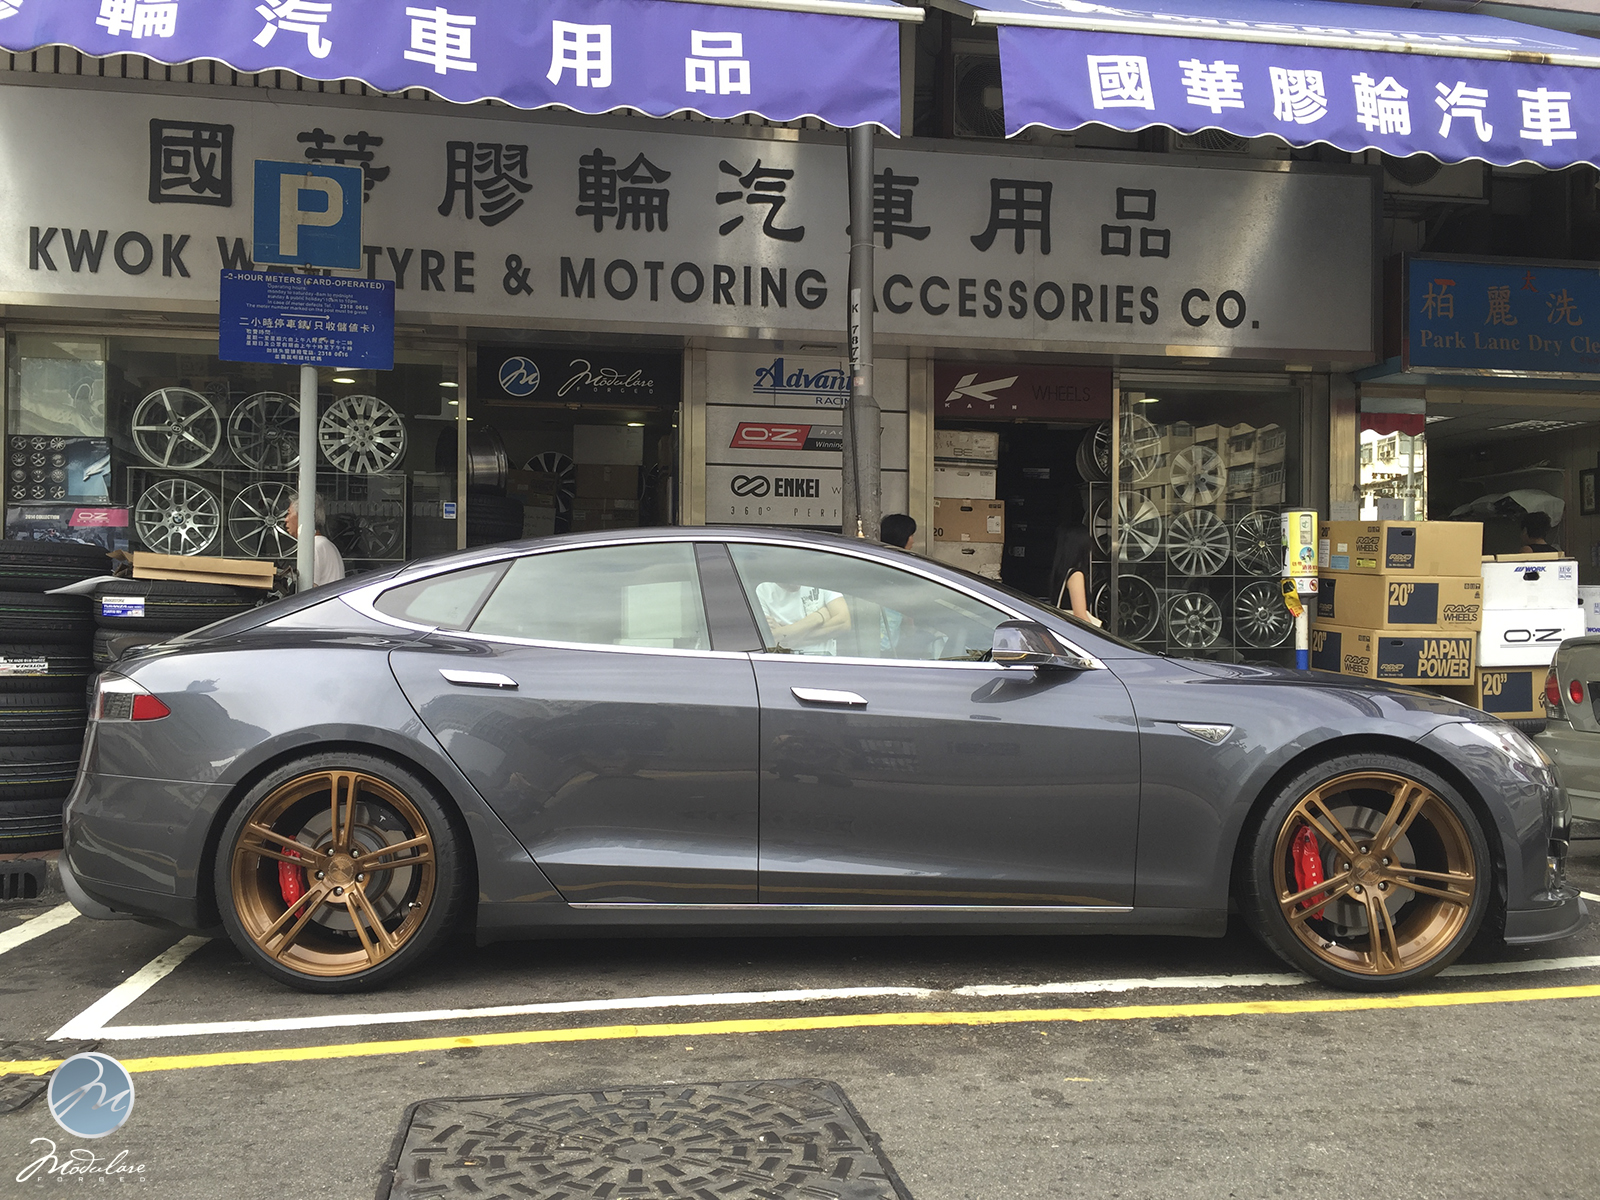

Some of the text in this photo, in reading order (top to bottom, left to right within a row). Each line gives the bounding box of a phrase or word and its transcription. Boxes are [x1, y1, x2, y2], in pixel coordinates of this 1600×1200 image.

[0, 0, 753, 96] 輪汽車用品
[1086, 54, 1577, 147] 國華膠輪汽車
[29, 227, 191, 277] KWOK
[504, 254, 534, 296] &
[561, 257, 828, 310] MOTORING
[873, 274, 1160, 325] CCESSORIES
[1181, 289, 1260, 329] CO.
[265, 275, 302, 284] METERS
[303, 278, 386, 291] (CARD-OPERATED)
[1420, 330, 1466, 349] Park
[1473, 332, 1520, 350] Lane
[1528, 335, 1562, 356] Dry
[576, 386, 654, 395] FORGED
[1032, 385, 1091, 401] WHEELS
[774, 477, 820, 498] ENKEI
[1443, 604, 1480, 613] RAYS
[1444, 614, 1478, 622] WHEELS
[1418, 640, 1470, 659] JAPAN
[1344, 663, 1369, 674] WHEELS
[1417, 659, 1469, 677] POWER
